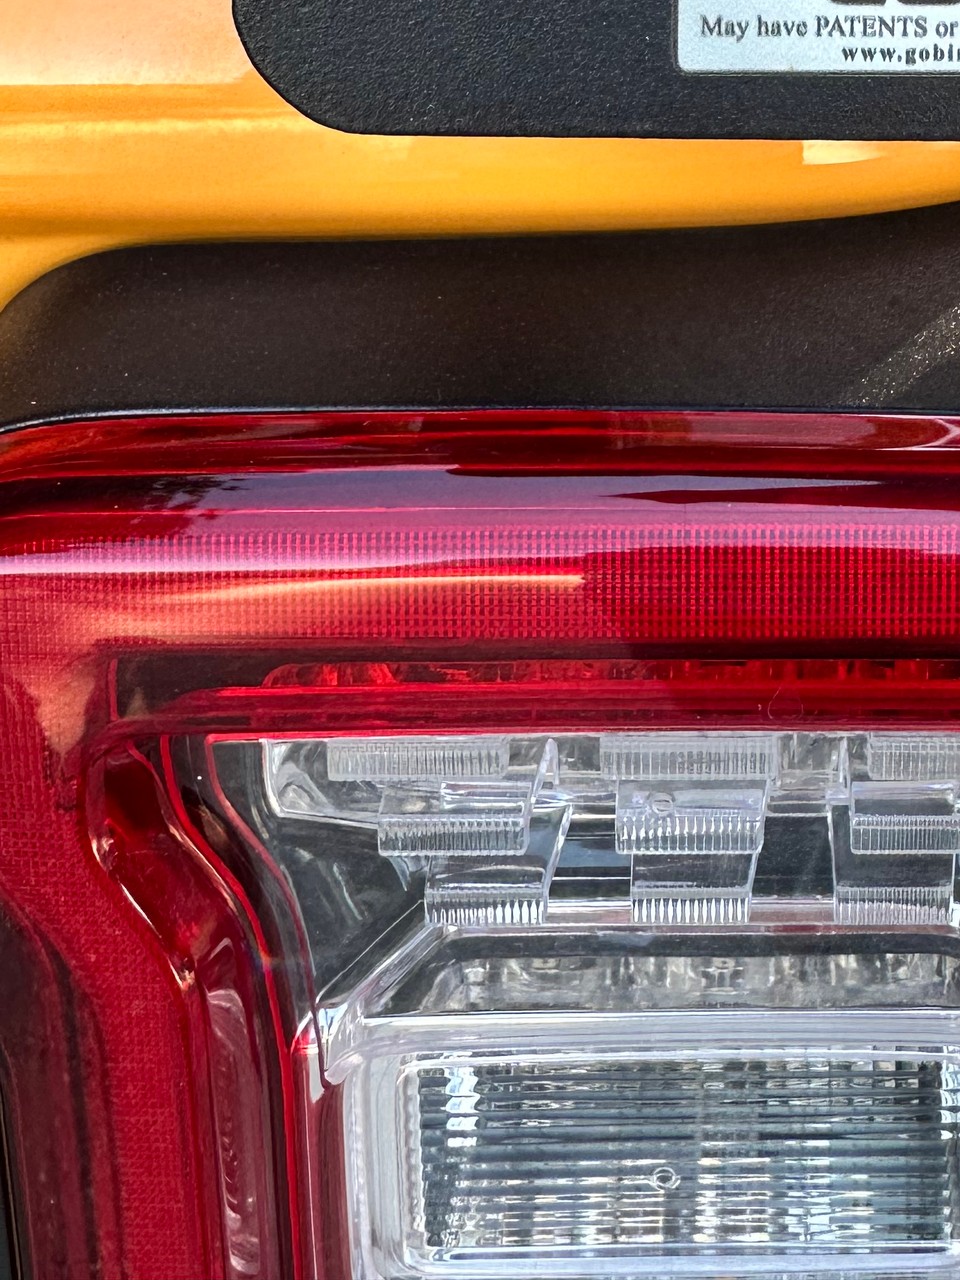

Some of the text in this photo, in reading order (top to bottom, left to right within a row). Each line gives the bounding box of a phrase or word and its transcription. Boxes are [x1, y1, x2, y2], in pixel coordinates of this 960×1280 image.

[700, 14, 749, 43] May
[757, 14, 808, 38] have
[815, 14, 928, 38] PATENTS
[935, 21, 959, 38] or
